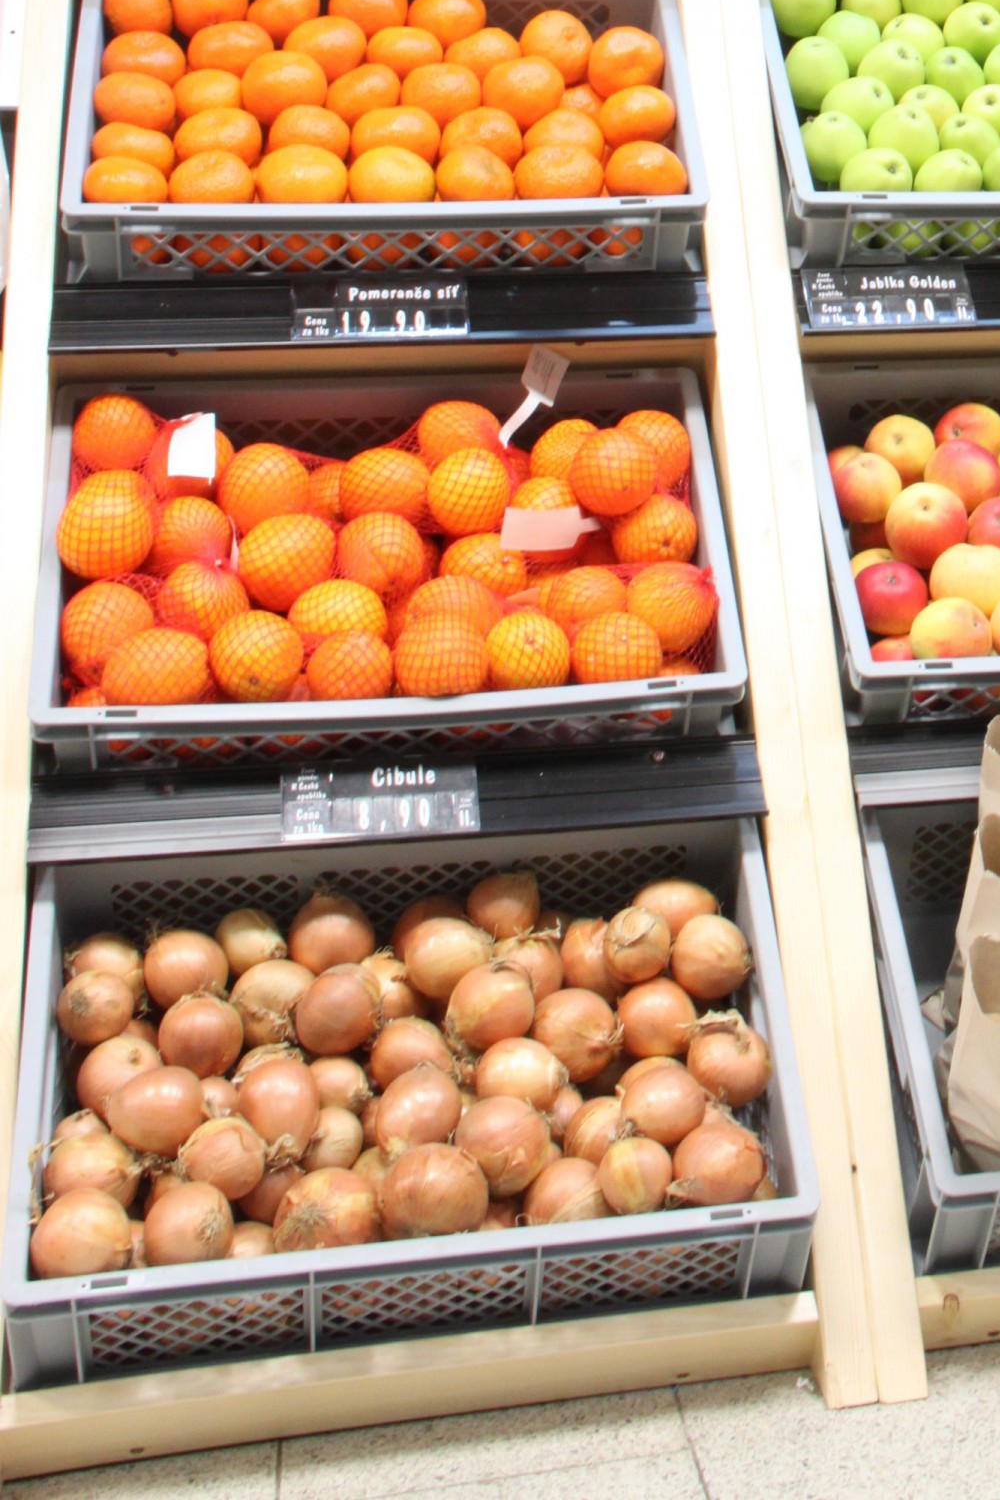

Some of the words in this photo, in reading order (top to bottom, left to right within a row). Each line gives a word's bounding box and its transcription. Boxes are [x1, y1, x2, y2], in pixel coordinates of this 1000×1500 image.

[860, 275, 905, 290] Jablka
[909, 275, 956, 290] Golden
[349, 286, 431, 302] Pomeranče
[304, 315, 327, 326] Cena
[371, 764, 436, 788] Cibule
[296, 809, 320, 821] Cena
